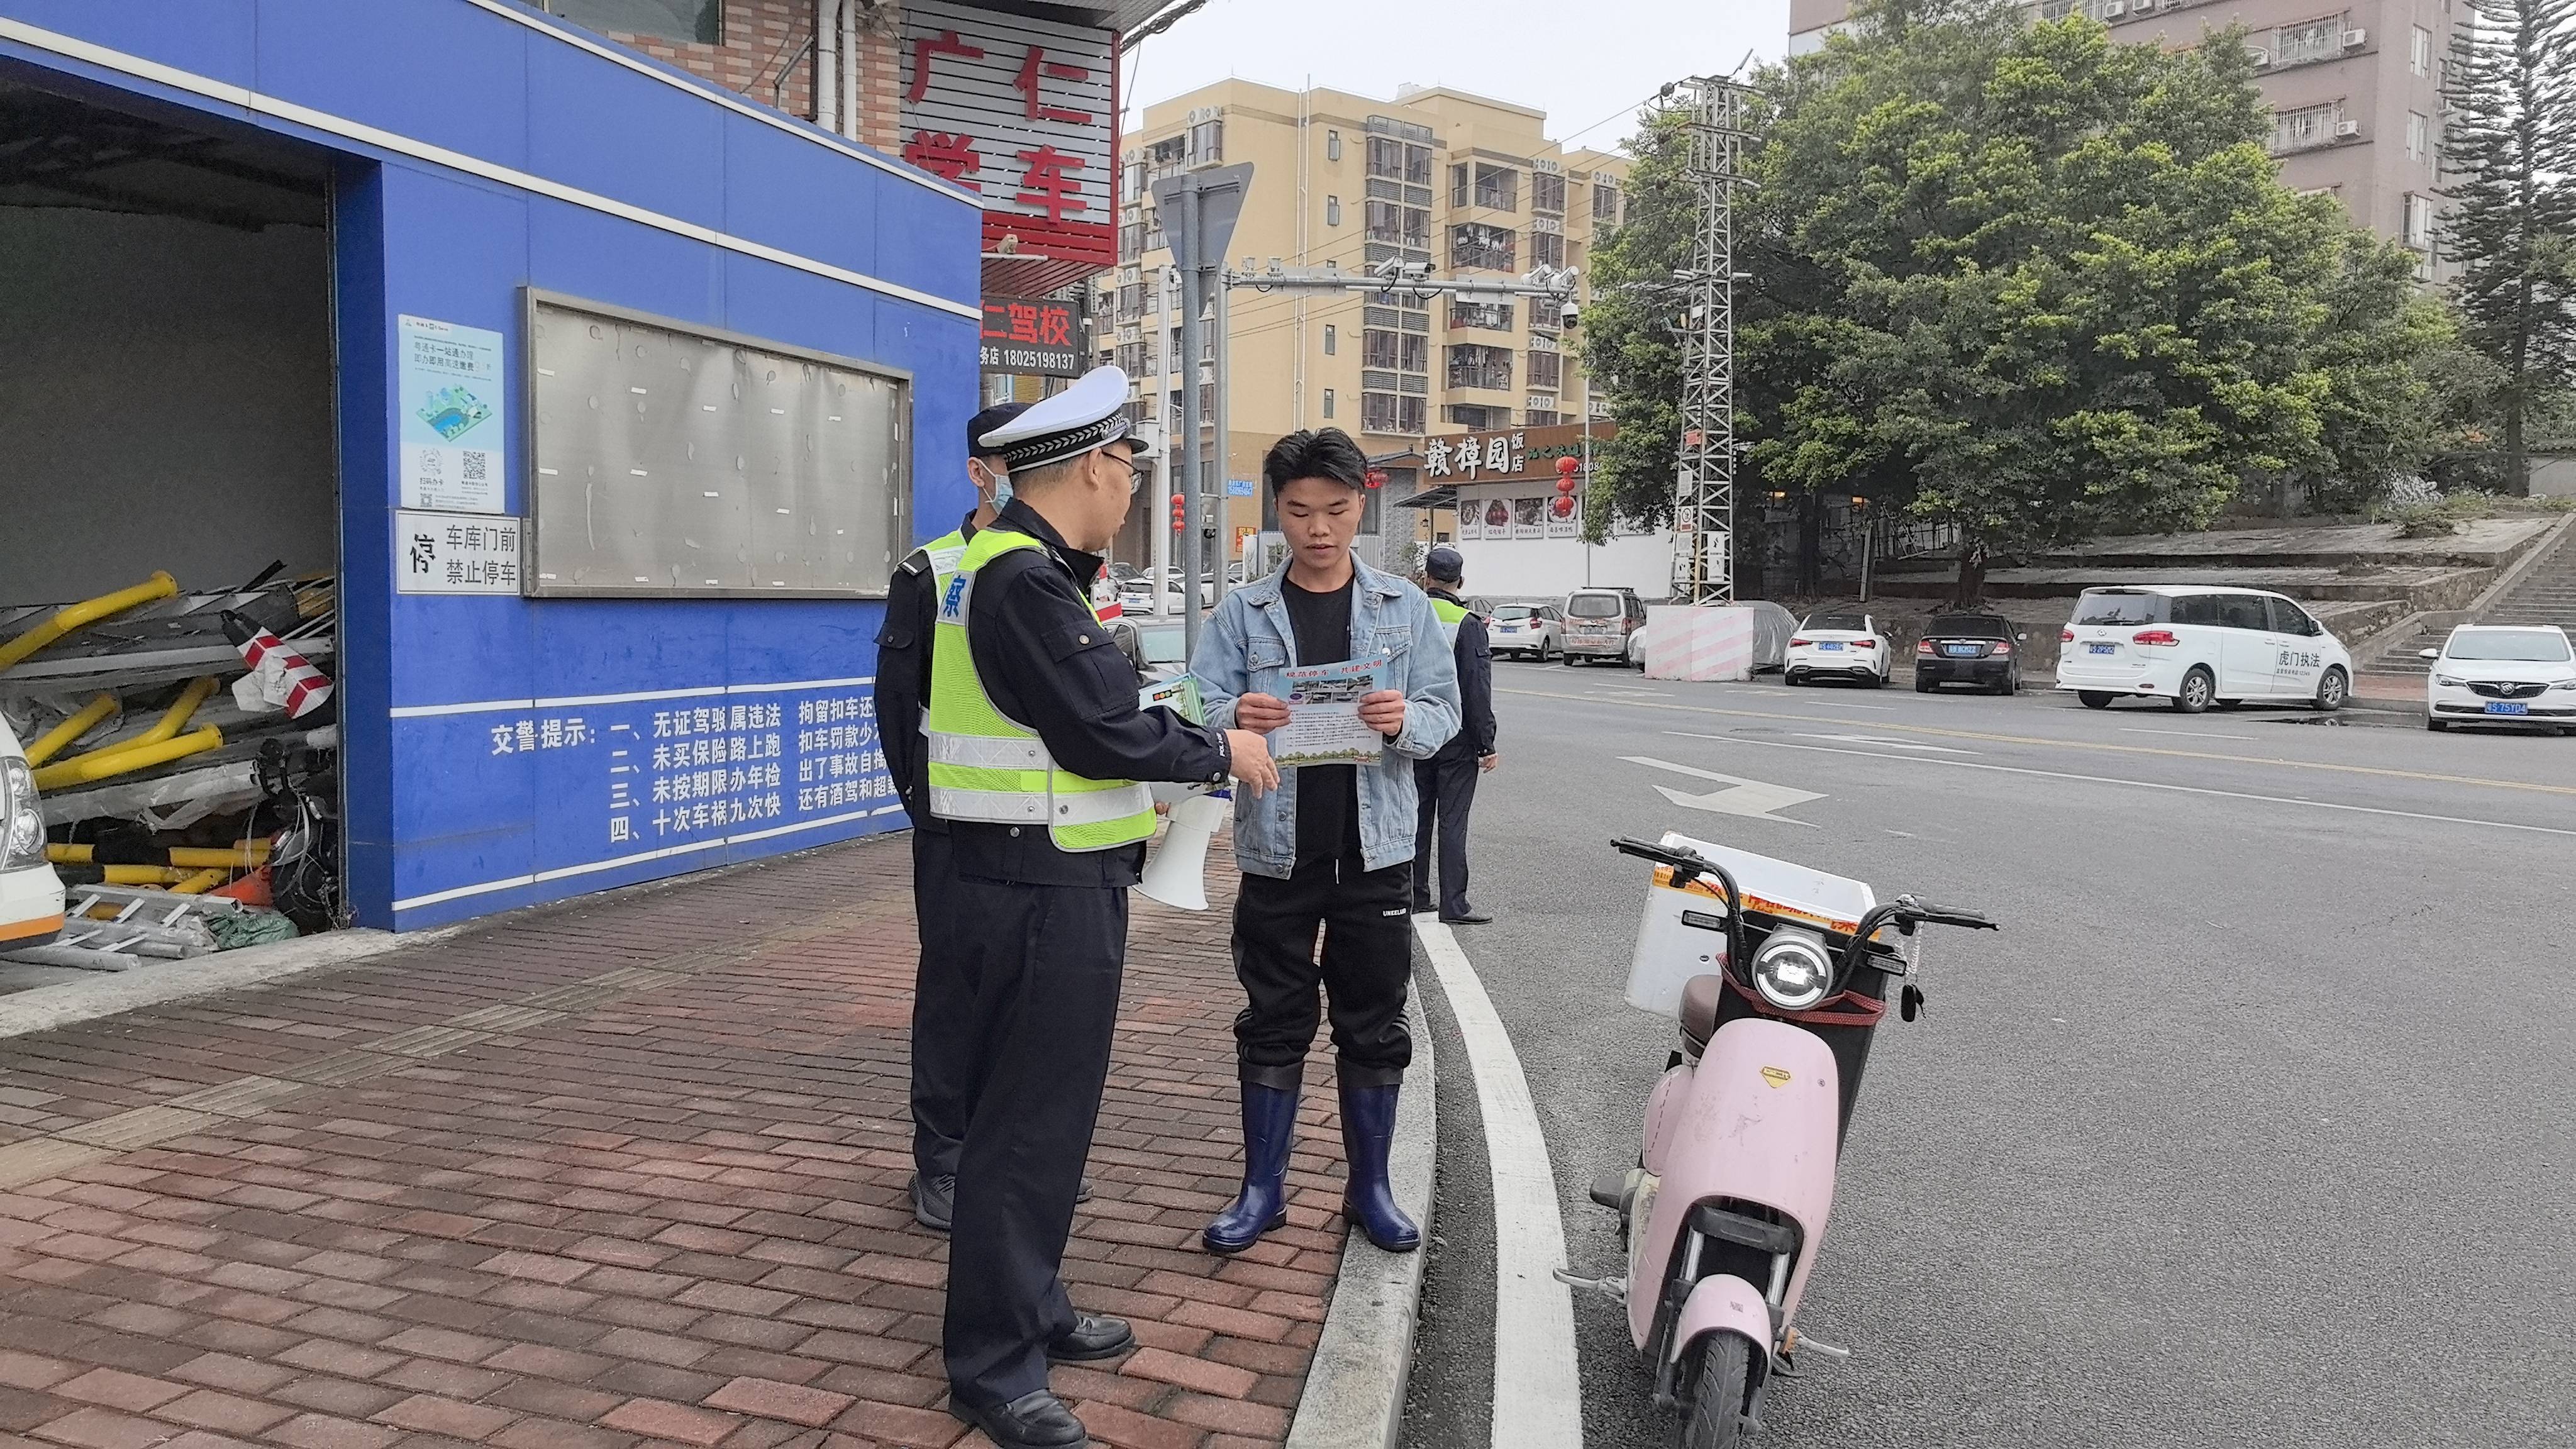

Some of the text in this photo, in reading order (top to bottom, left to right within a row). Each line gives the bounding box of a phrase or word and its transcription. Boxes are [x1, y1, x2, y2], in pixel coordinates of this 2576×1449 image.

[905, 30, 1092, 121] 广仁
[1004, 349, 1075, 370] 18025198137
[1511, 432, 1525, 473] 饭店
[447, 523, 516, 552] 车库门前
[447, 558, 516, 586] 禁止停车
[2279, 650, 2320, 667] 虎门执法
[799, 696, 876, 725] 拘留扣车还
